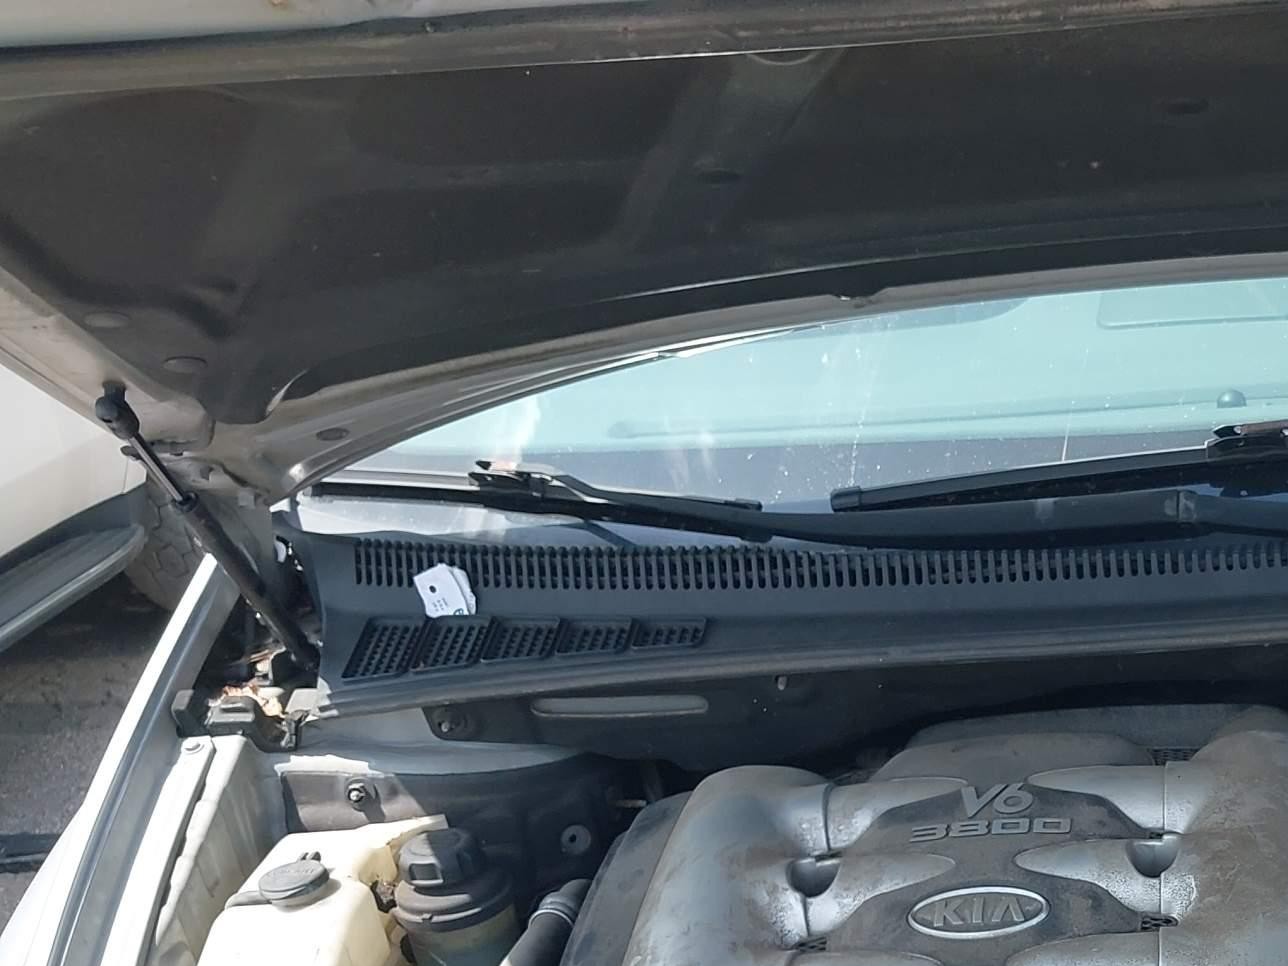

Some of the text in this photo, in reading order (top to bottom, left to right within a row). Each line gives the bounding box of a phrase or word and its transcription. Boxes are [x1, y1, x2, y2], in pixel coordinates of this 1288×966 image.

[960, 782, 1033, 818] V6
[909, 816, 1072, 843] 3800
[932, 896, 1025, 927] KIA
